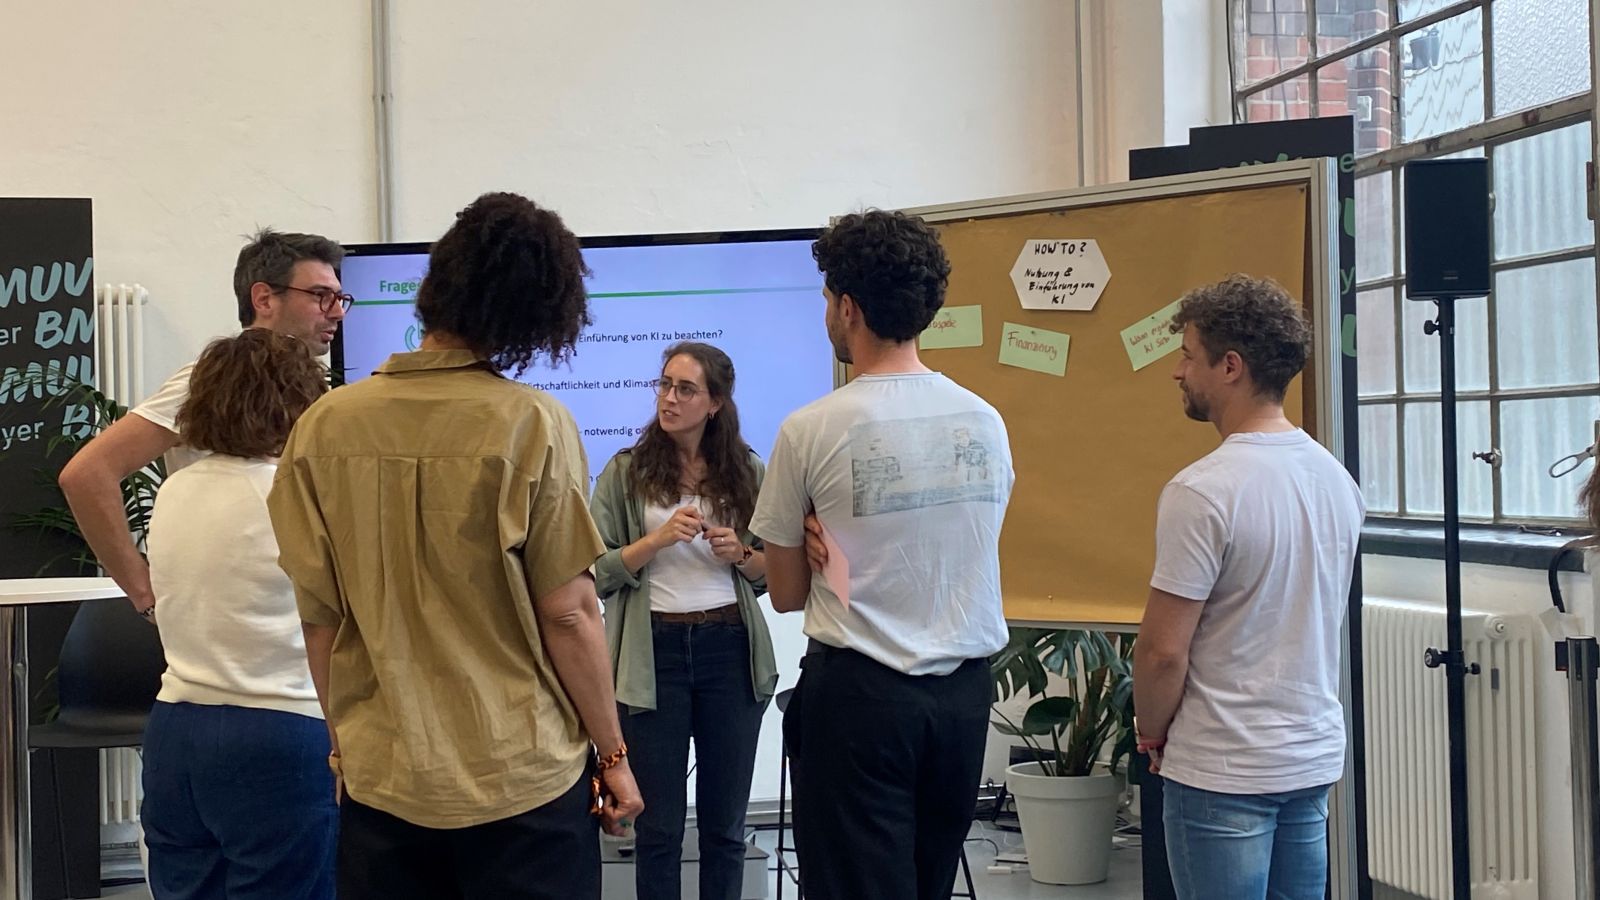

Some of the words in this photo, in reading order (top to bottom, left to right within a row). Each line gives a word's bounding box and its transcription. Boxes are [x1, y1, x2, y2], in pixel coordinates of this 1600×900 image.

[1035, 242, 1059, 255] HOW
[1051, 294, 1066, 305] KI
[579, 333, 629, 343] Einführung
[650, 331, 660, 341] KI
[675, 329, 723, 340] beachten?
[603, 380, 620, 388] und
[623, 378, 655, 388] Klimas
[62, 404, 98, 440] B
[584, 426, 633, 437] notwendig
